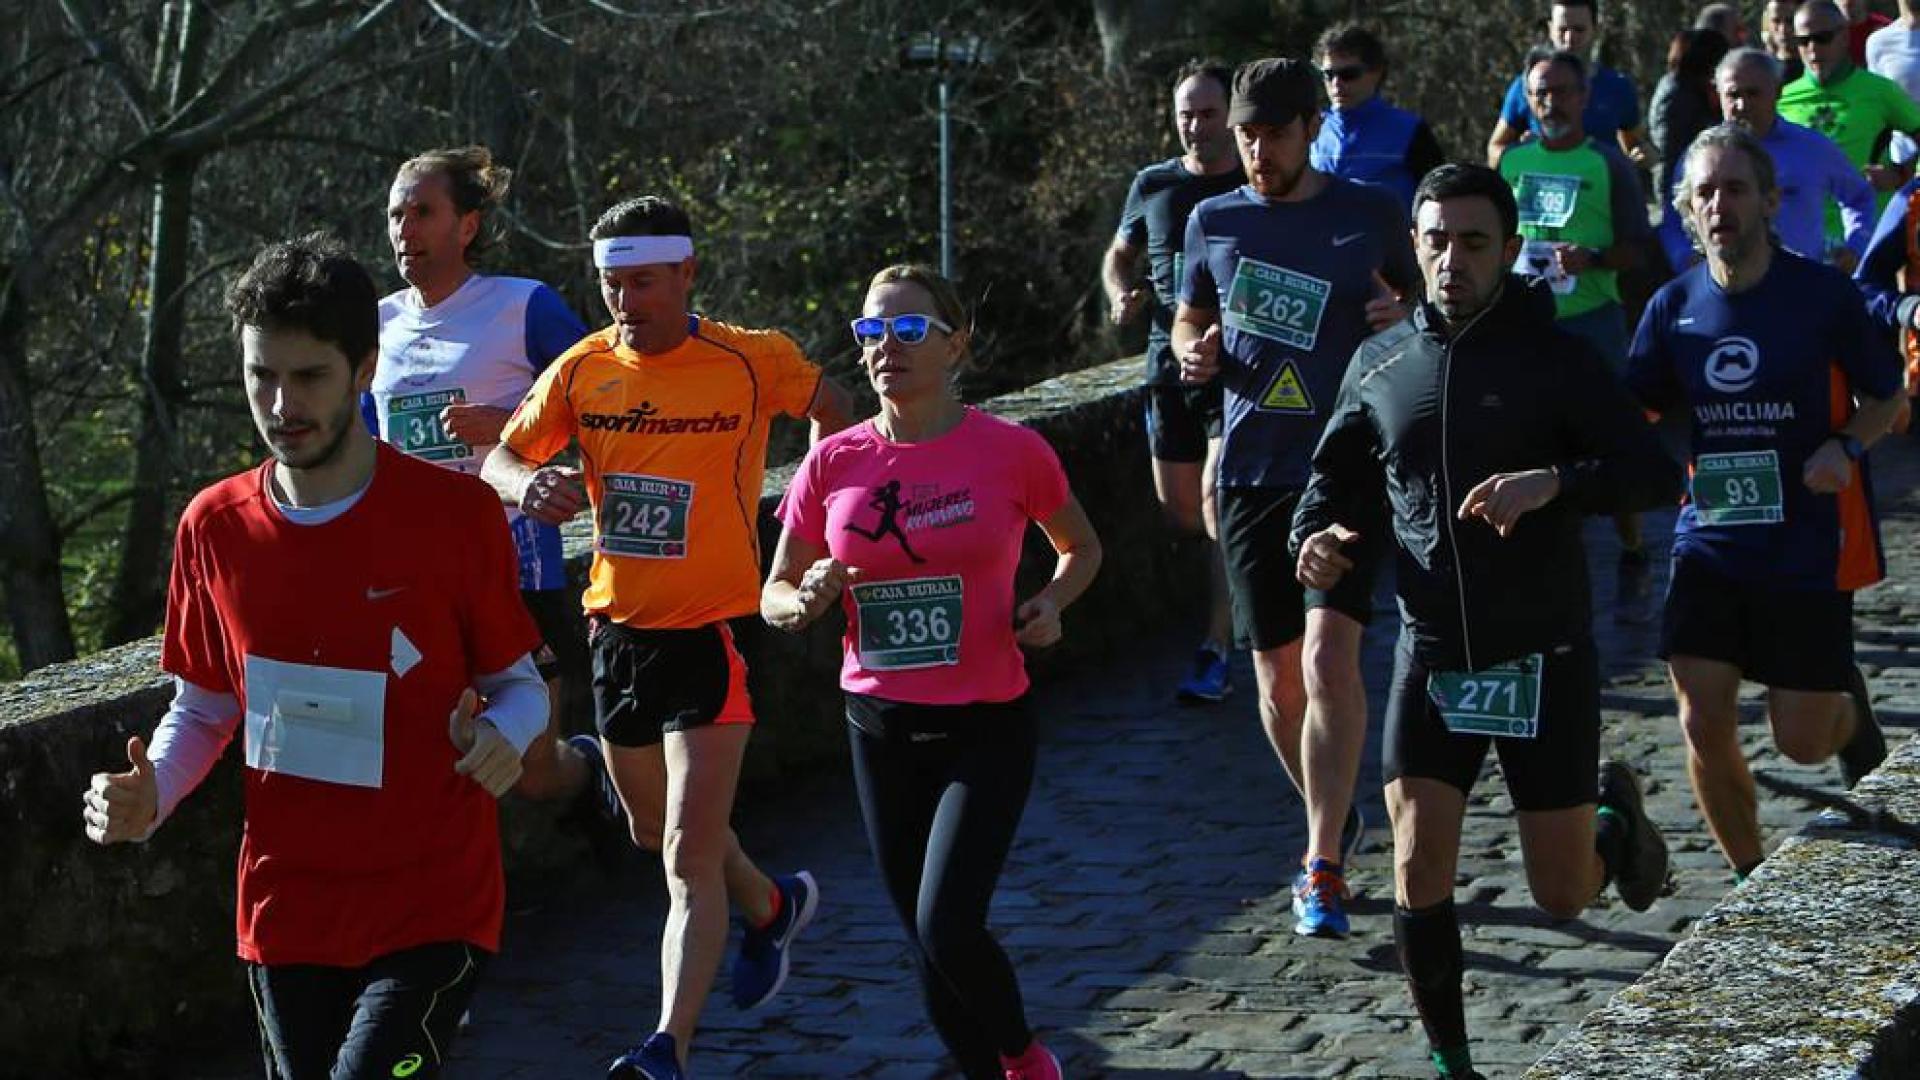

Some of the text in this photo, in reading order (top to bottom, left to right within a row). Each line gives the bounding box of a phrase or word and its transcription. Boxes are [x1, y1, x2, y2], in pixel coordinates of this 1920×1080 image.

[1253, 289, 1308, 328] 262
[409, 413, 450, 446] 31
[1725, 477, 1761, 505] 93
[615, 501, 672, 536] 242
[872, 582, 959, 600] CAJA RURAL
[887, 606, 951, 645] 336
[1457, 679, 1518, 714] 271
